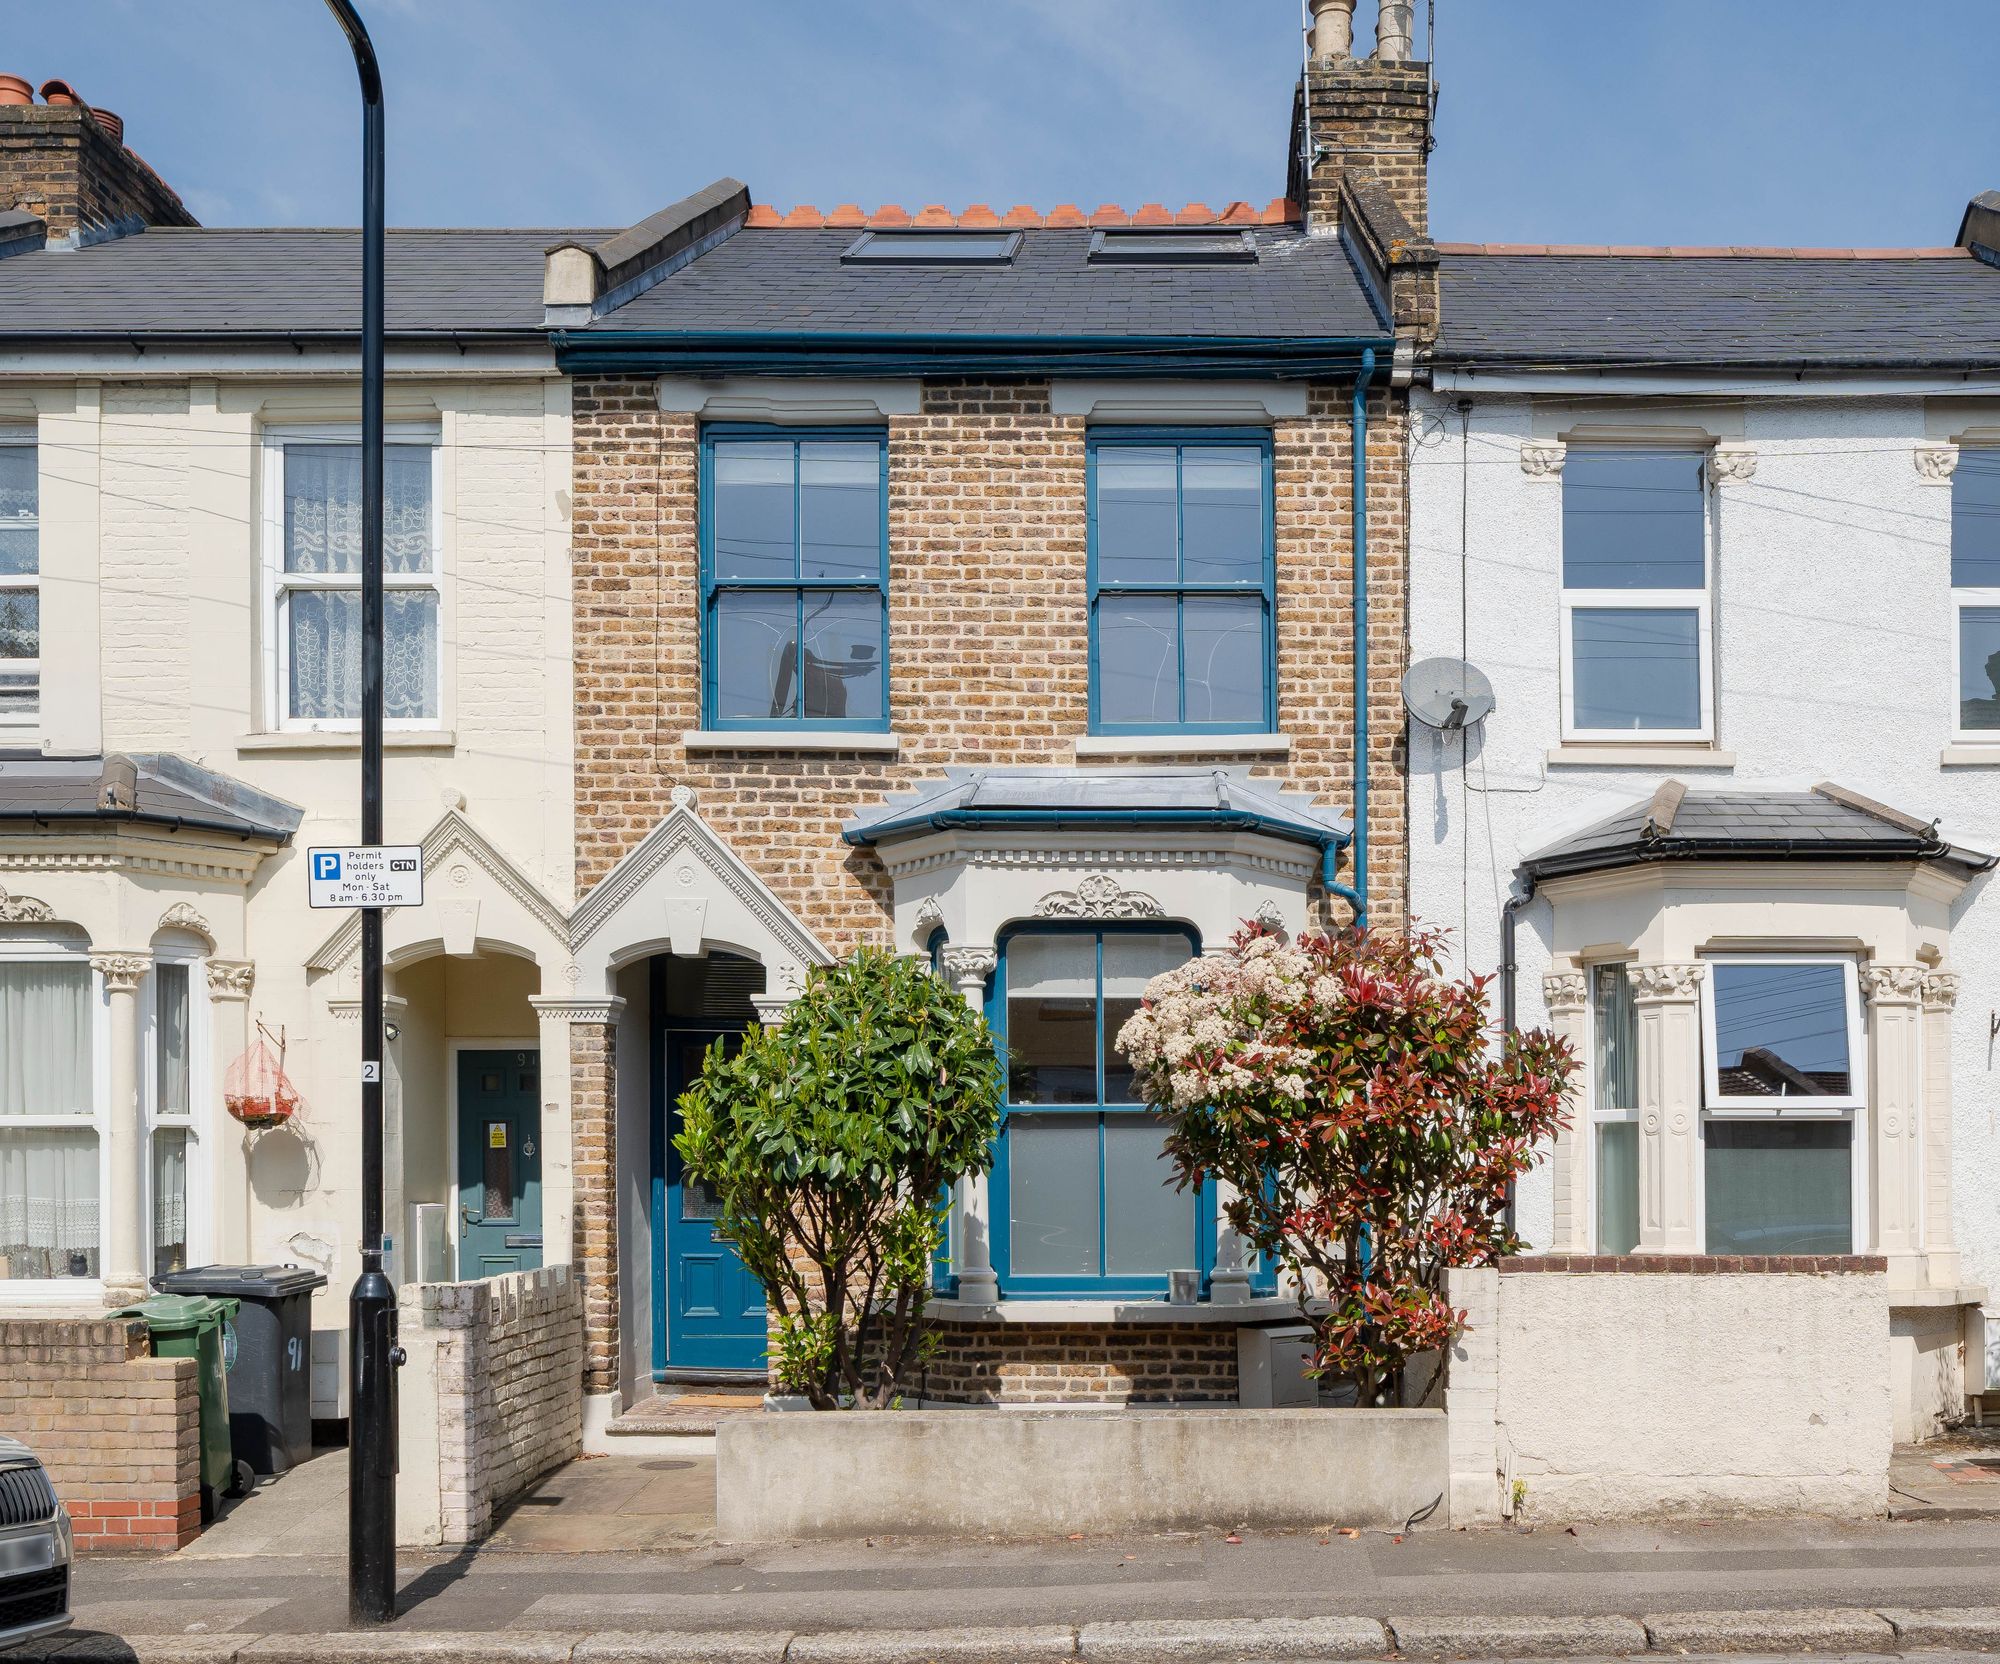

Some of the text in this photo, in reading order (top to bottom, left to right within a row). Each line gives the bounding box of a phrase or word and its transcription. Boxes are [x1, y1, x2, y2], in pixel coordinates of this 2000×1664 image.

[348, 851, 382, 859] Permit
[320, 856, 337, 878] P
[346, 862, 384, 870] holders
[392, 861, 415, 870] CTN
[355, 872, 376, 882] only
[342, 883, 364, 891] Mon
[372, 882, 390, 891] Sat
[329, 893, 336, 902] 8
[361, 893, 386, 901] 6.30
[388, 894, 402, 902] pm
[364, 1064, 374, 1079] 2
[287, 1337, 302, 1371] 91
